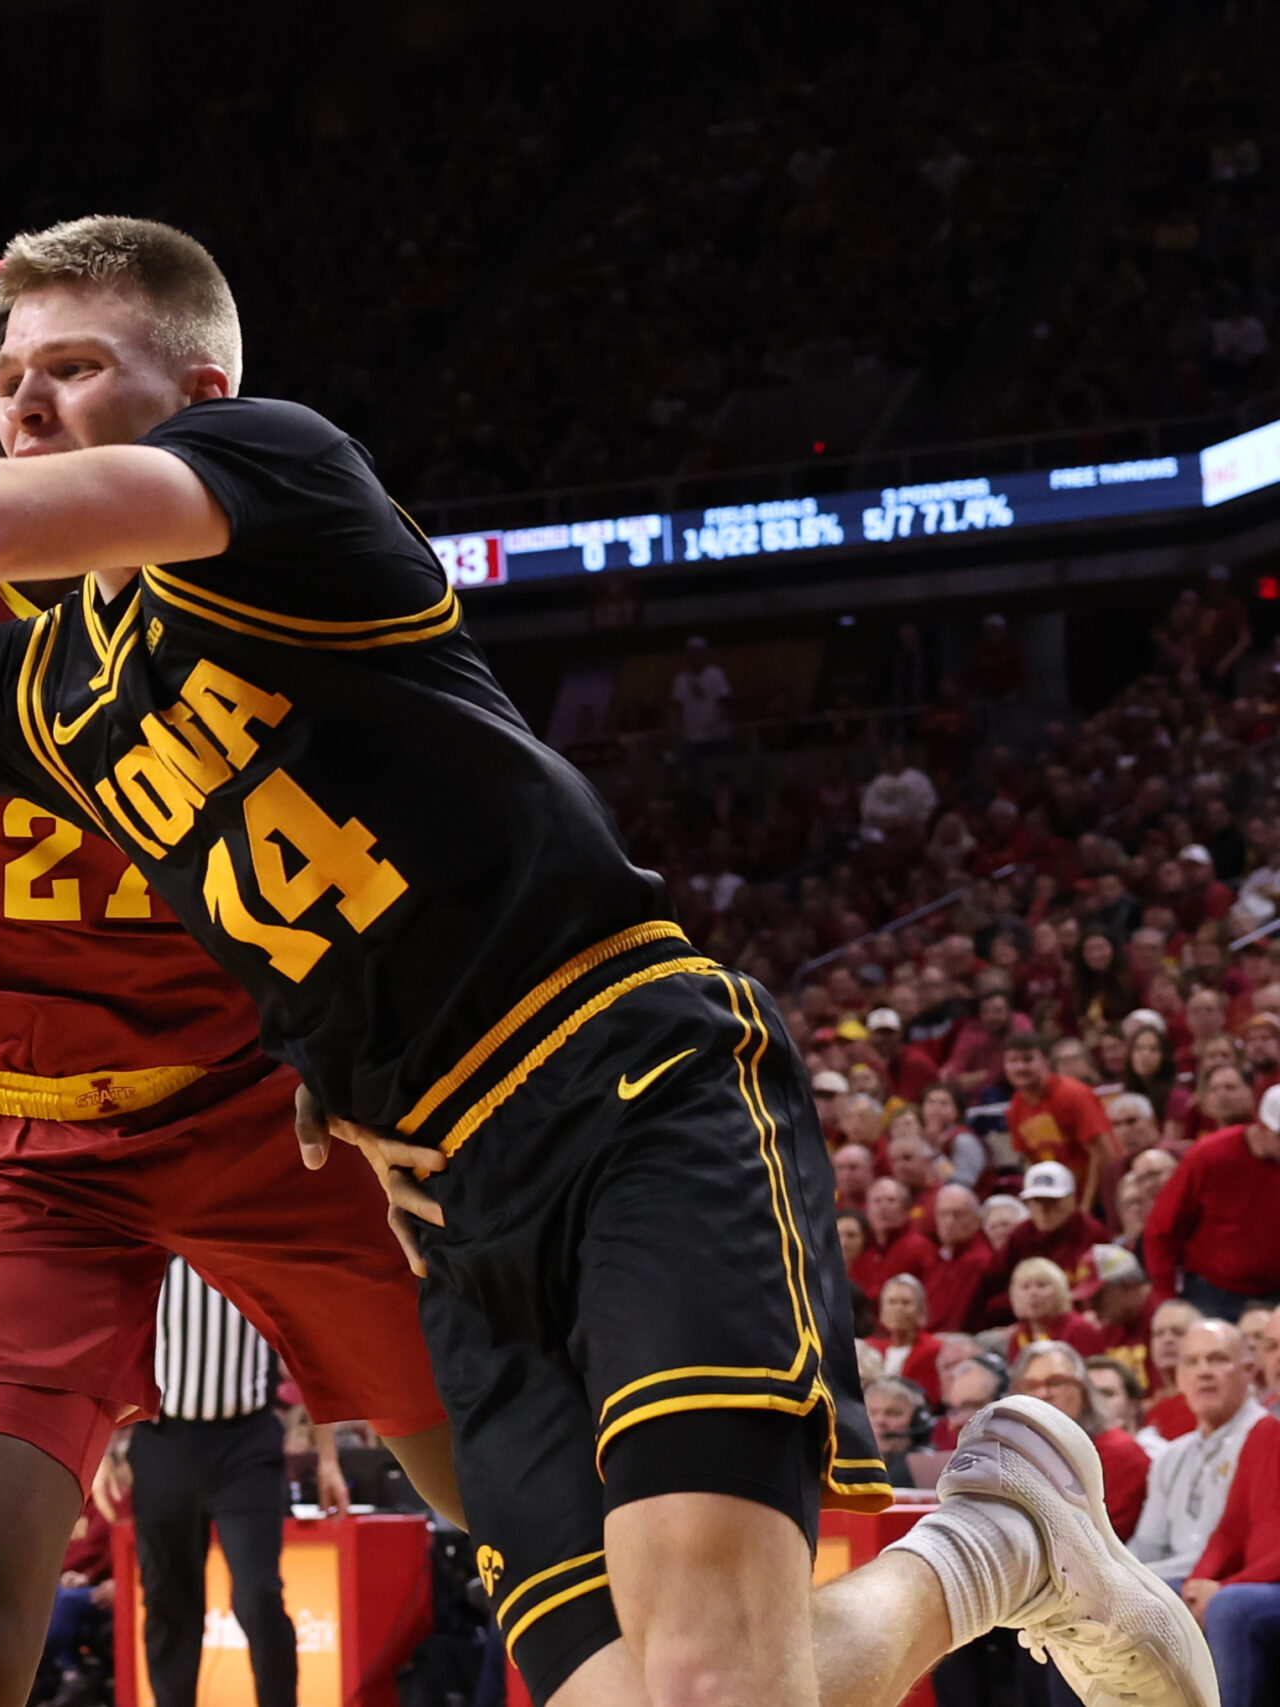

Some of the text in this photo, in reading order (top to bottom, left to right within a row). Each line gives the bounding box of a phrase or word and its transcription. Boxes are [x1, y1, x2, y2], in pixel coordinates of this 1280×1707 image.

[862, 504, 915, 542] 5/7
[94, 658, 293, 860] IOWA
[203, 767, 409, 983] 14
